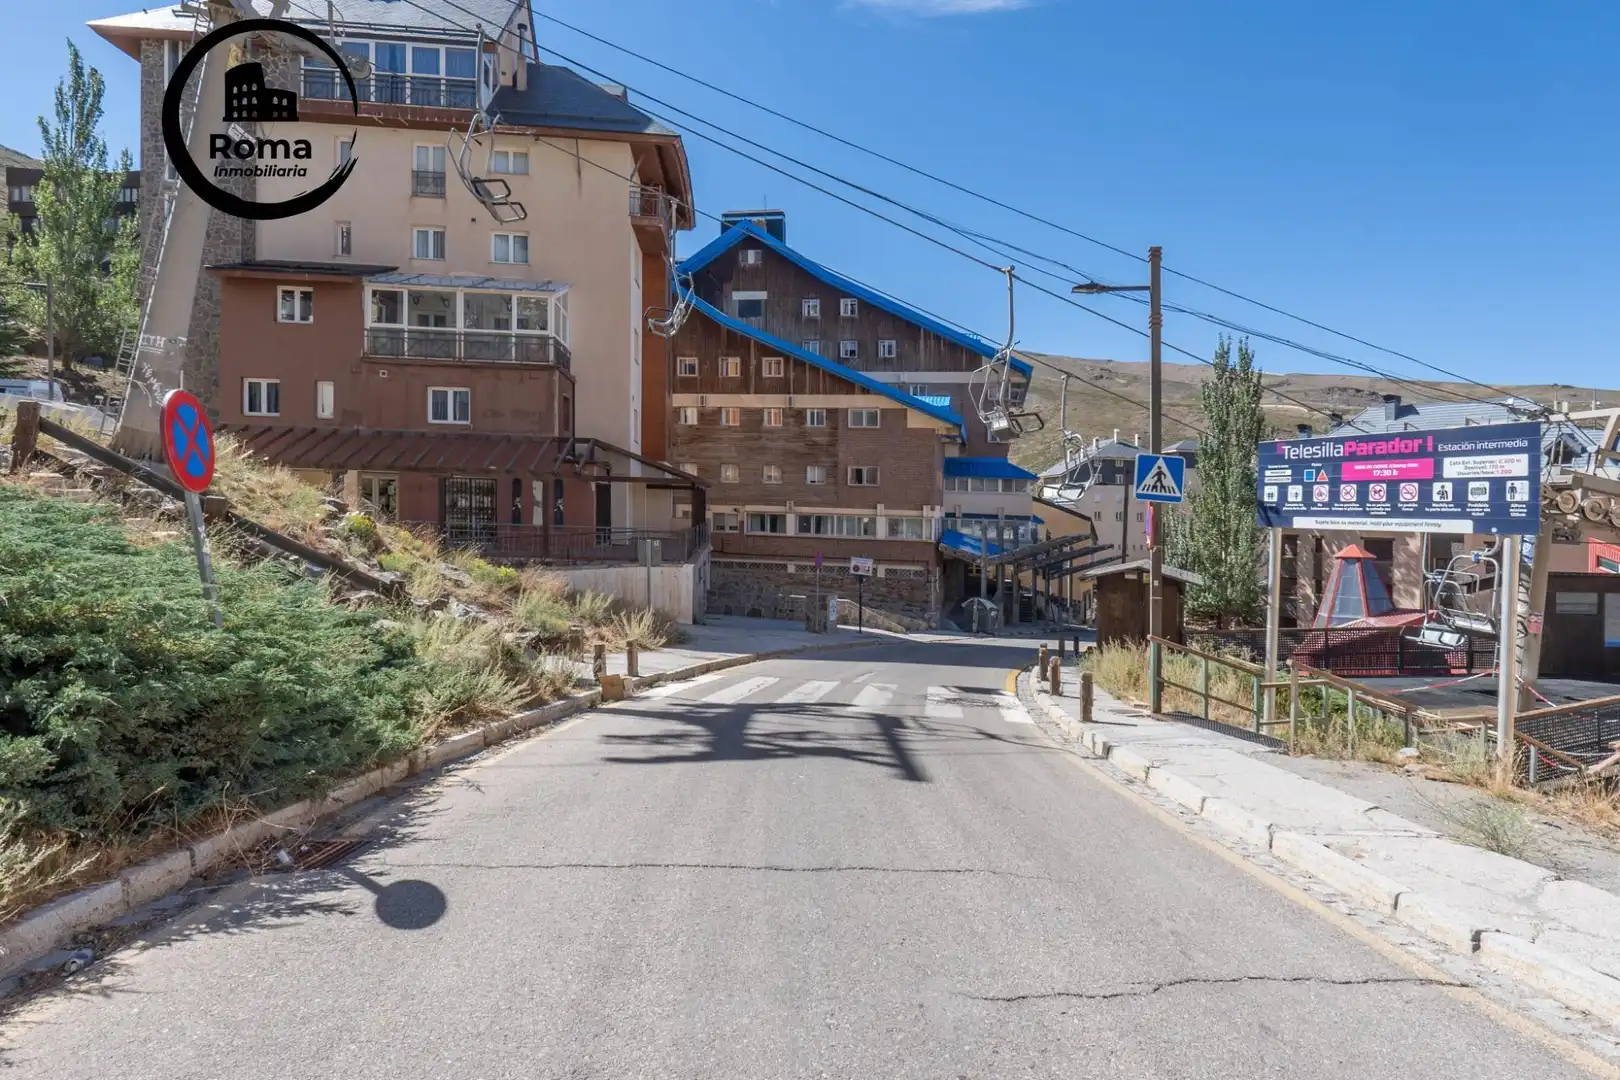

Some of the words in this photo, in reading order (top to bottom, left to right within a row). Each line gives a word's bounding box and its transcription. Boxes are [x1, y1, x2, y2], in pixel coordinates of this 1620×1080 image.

[1437, 442, 1475, 452] Estación
[1476, 438, 1528, 450] intermedia
[1372, 469, 1392, 477] 17:30
